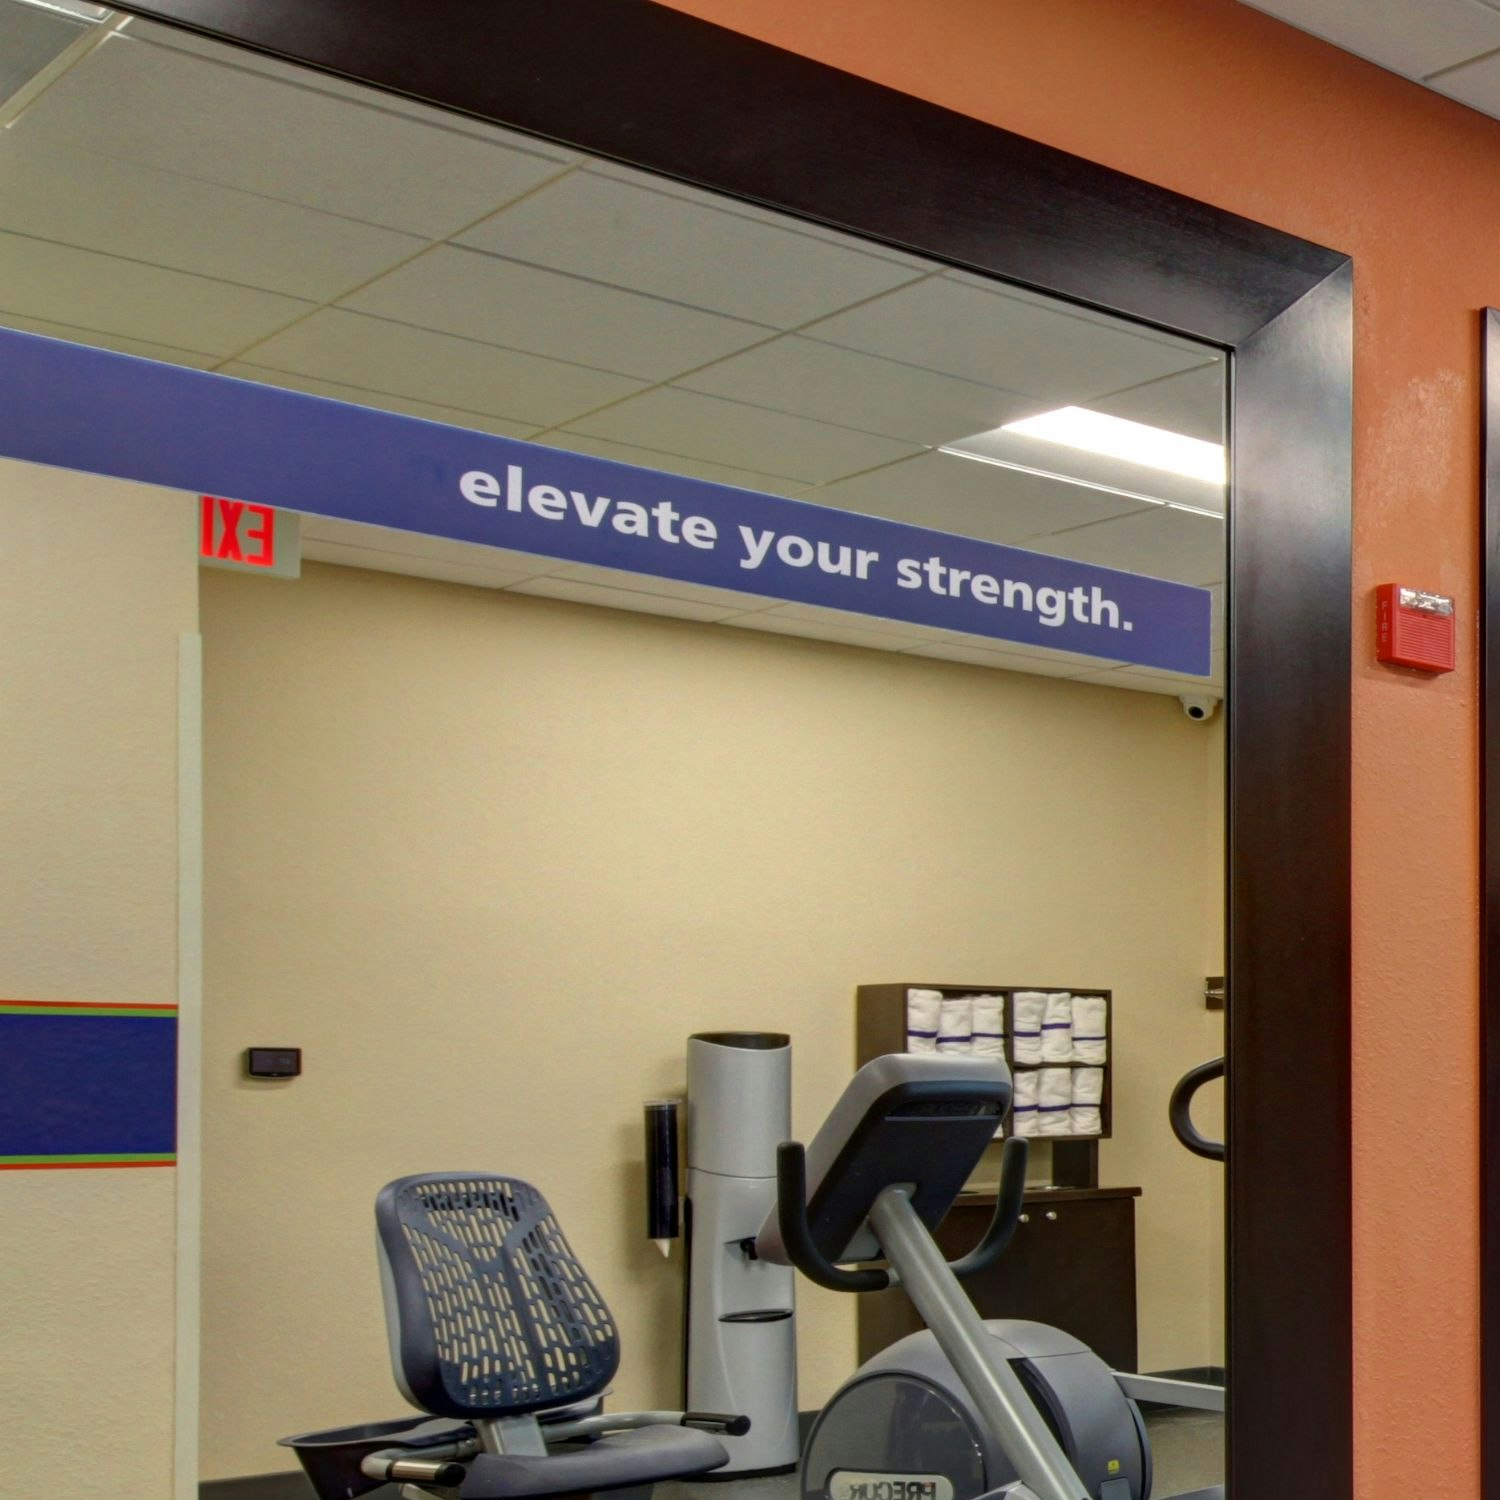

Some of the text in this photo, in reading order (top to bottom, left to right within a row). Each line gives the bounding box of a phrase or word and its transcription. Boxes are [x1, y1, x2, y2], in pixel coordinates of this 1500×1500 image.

[459, 464, 1133, 632] elevate your strength.
[1381, 601, 1389, 642] FIRE
